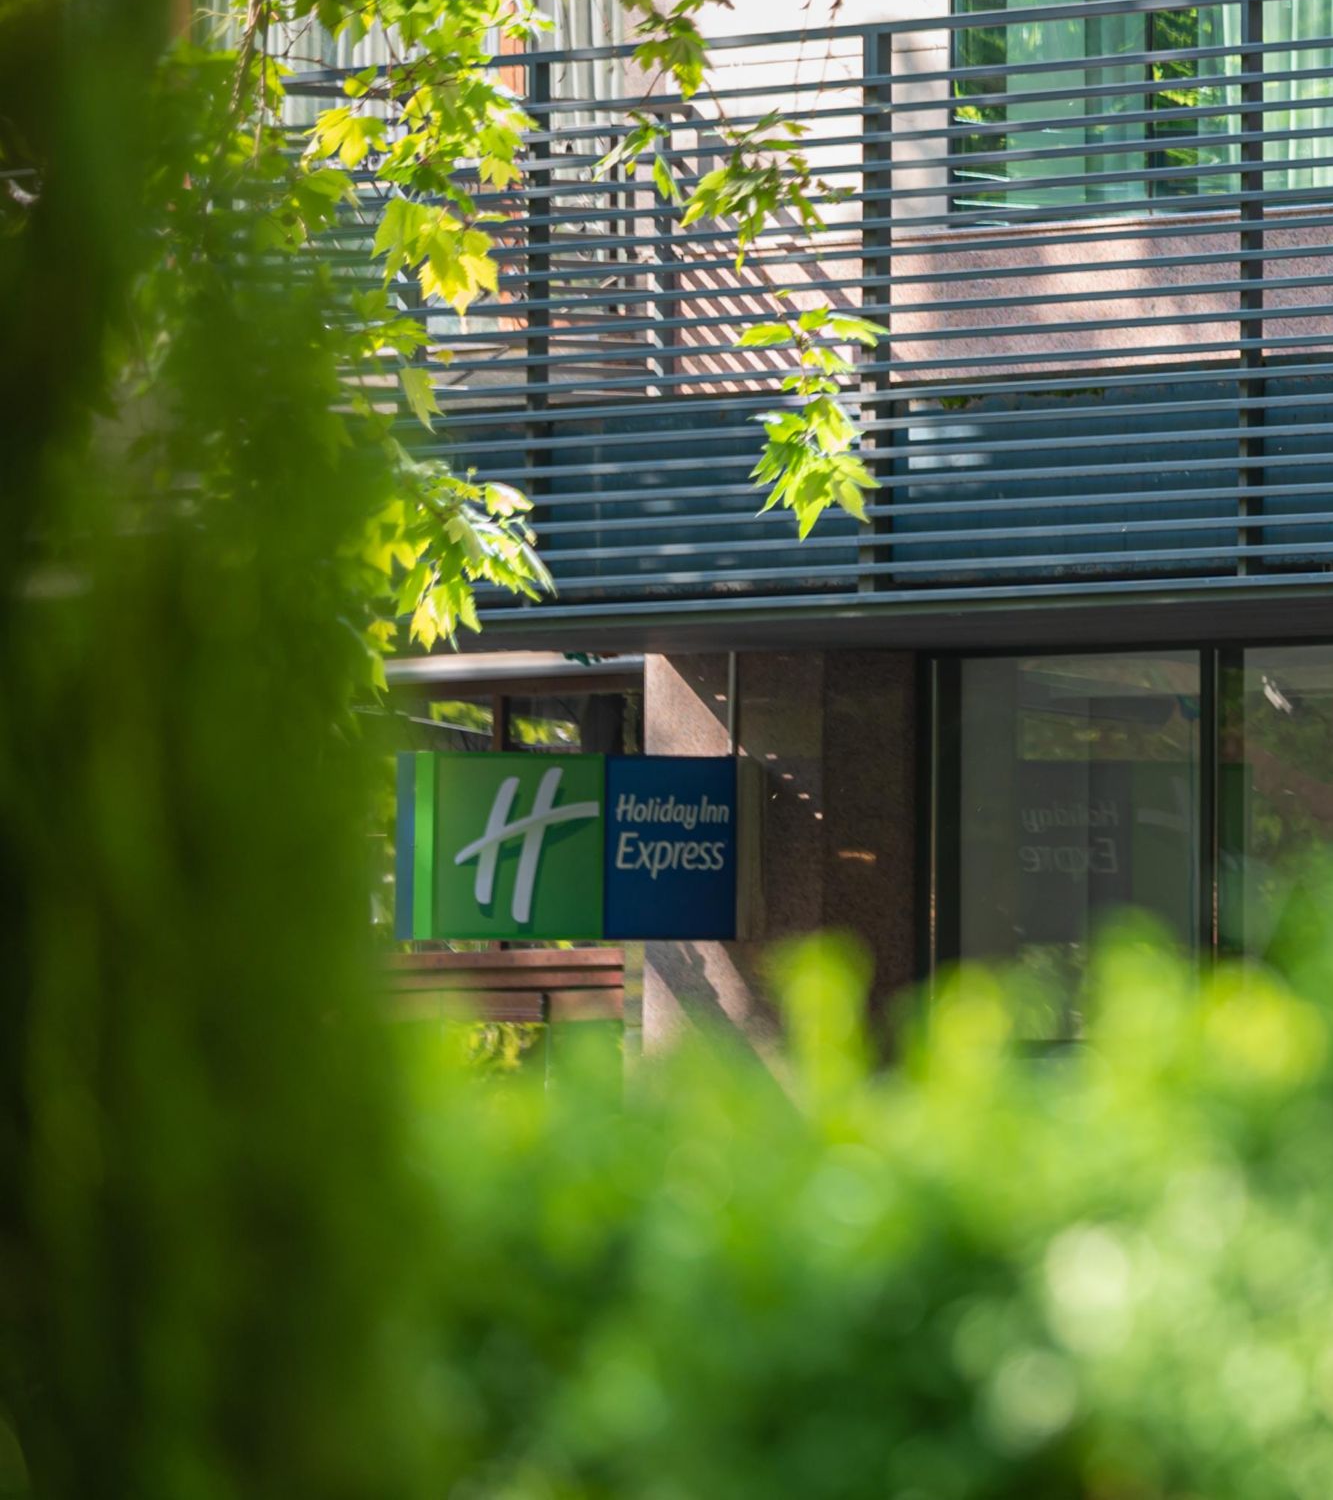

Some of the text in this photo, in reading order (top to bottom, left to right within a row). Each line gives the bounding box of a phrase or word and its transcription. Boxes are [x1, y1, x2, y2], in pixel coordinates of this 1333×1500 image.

[616, 794, 729, 830] Holiday Inn
[616, 832, 724, 879] Express
